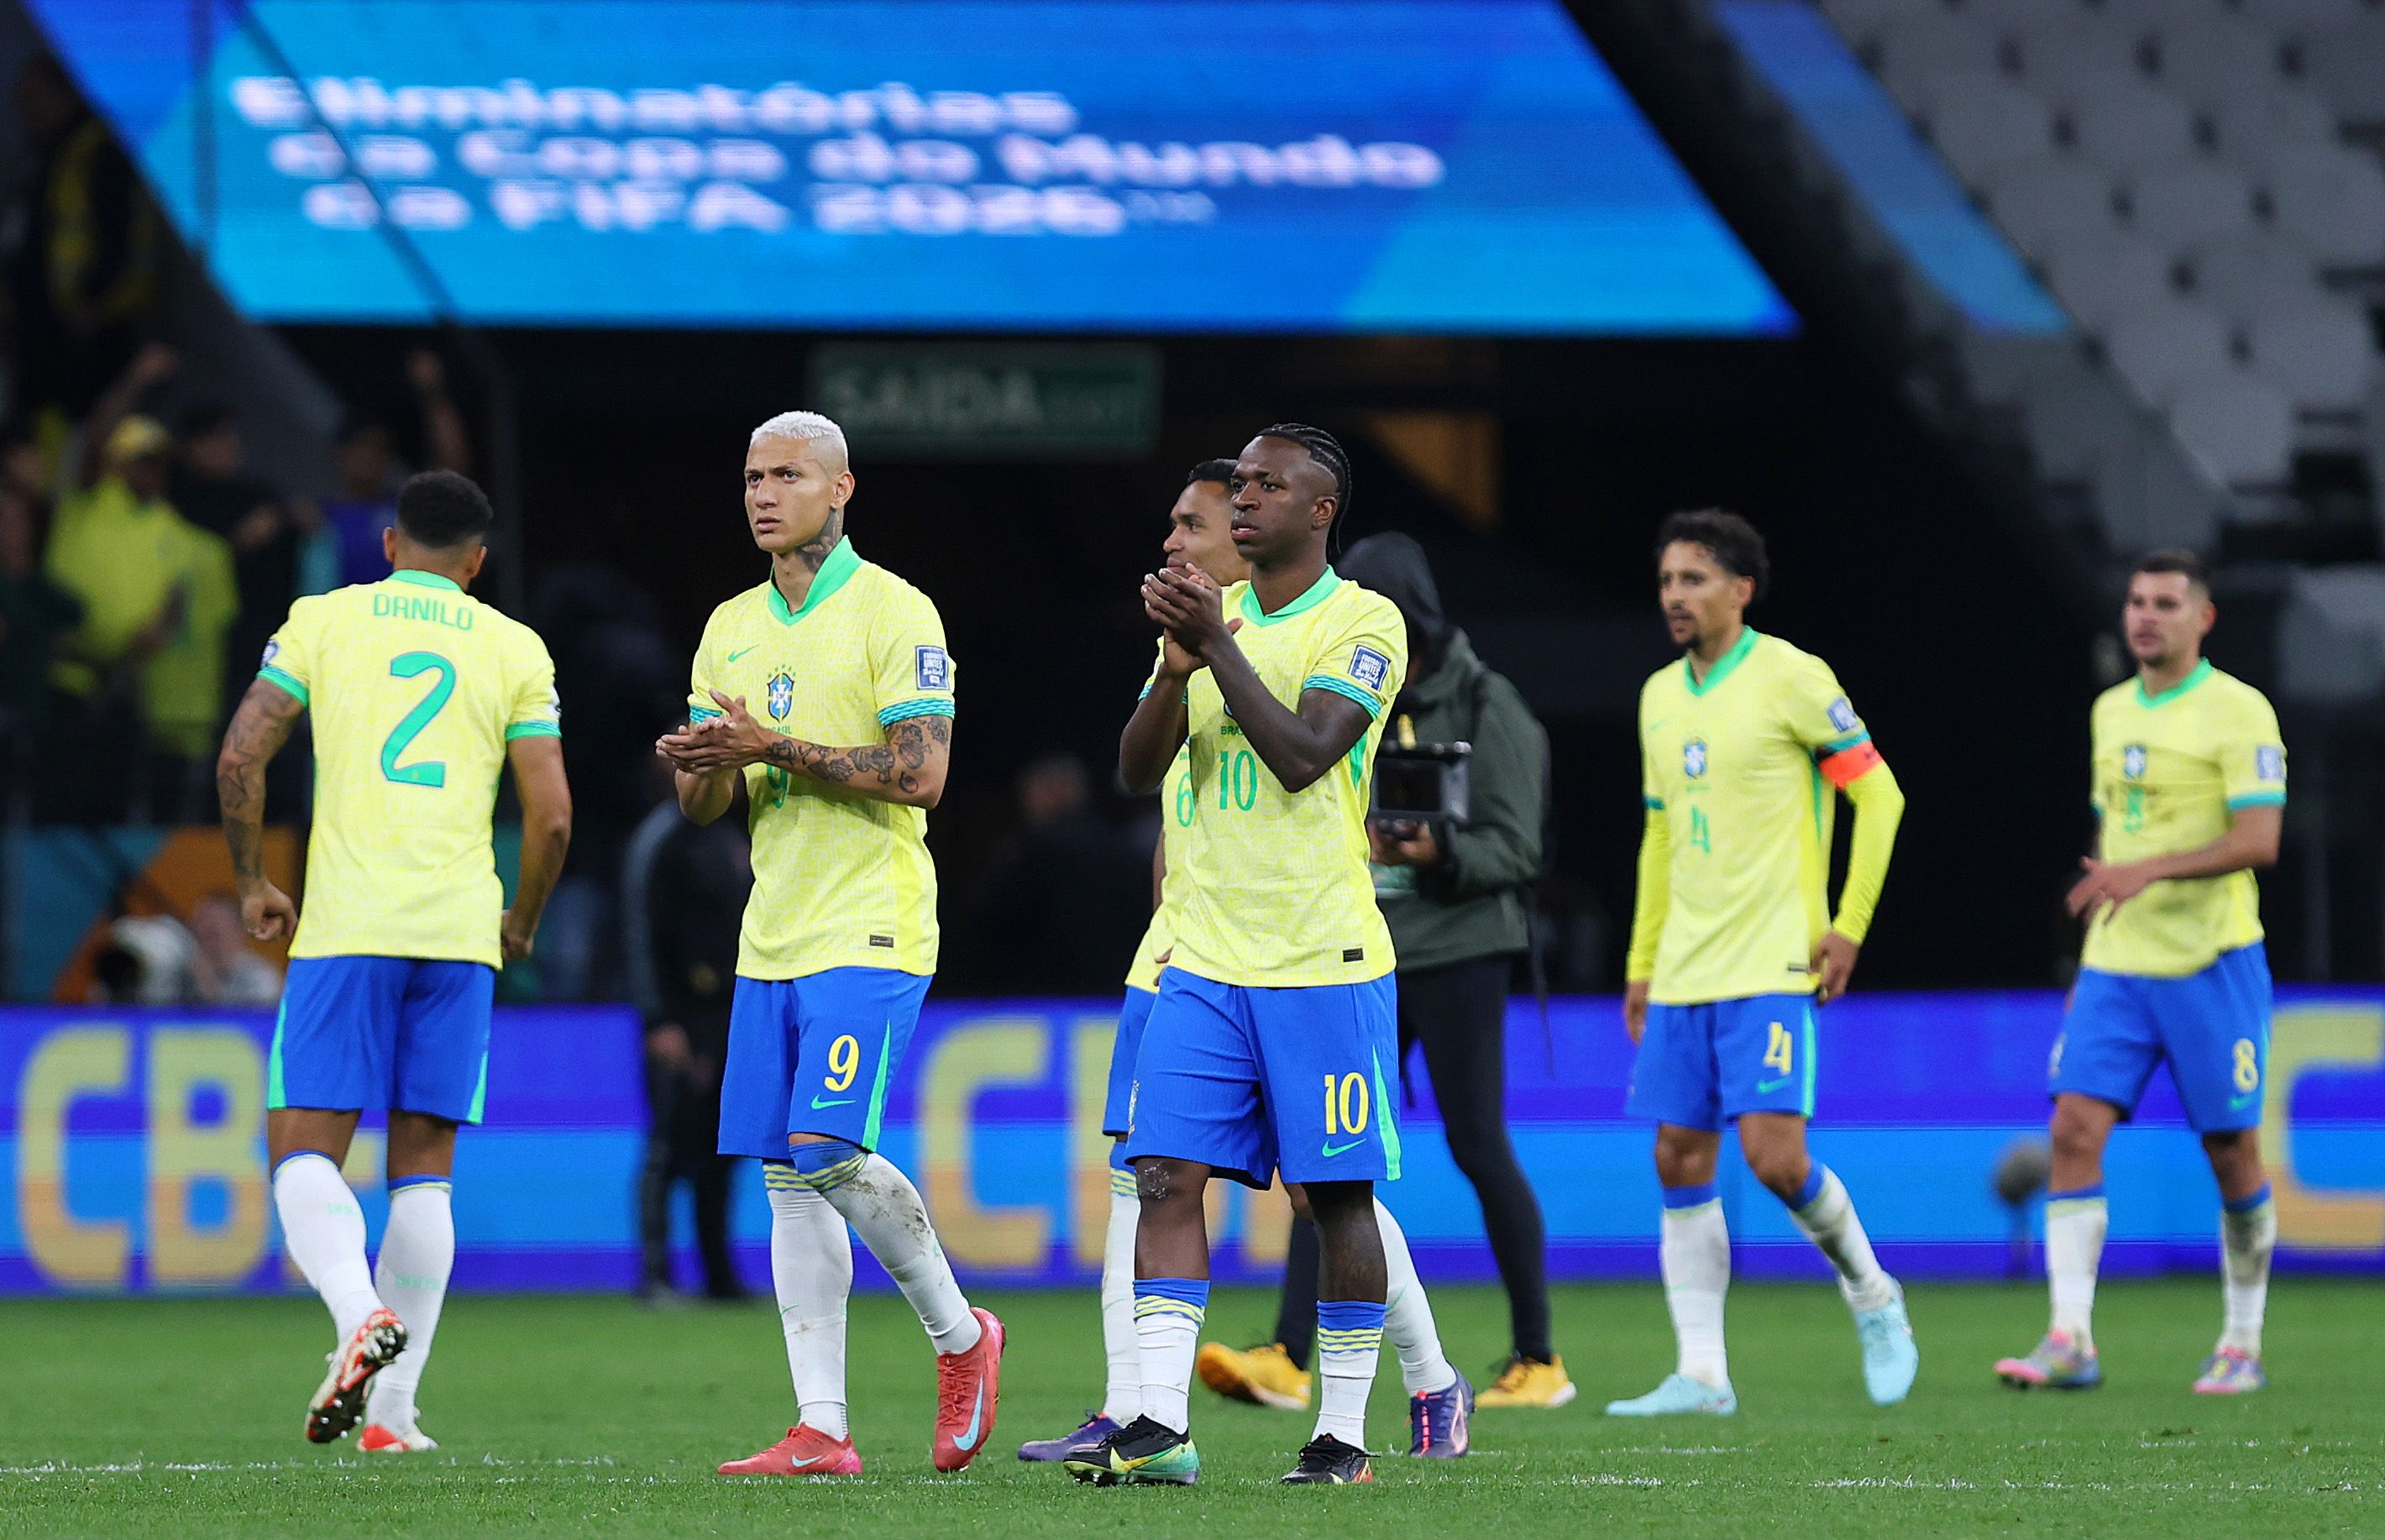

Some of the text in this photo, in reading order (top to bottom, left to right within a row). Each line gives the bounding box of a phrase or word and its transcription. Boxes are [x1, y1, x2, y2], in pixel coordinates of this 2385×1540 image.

[458, 129, 785, 182] Copa
[809, 130, 979, 184] do
[998, 134, 1443, 188] Mundo
[490, 180, 791, 232] FIFA
[811, 182, 1126, 236] 2026
[373, 593, 474, 631] DANILO
[381, 651, 456, 788] 2
[1177, 771, 1194, 827] 6
[1219, 750, 1257, 810] 10
[1691, 805, 1711, 854] 4
[824, 1035, 860, 1092] 9
[1764, 1021, 1793, 1075] 4
[2232, 1037, 2259, 1092] 8
[1324, 1071, 1369, 1134] 10
